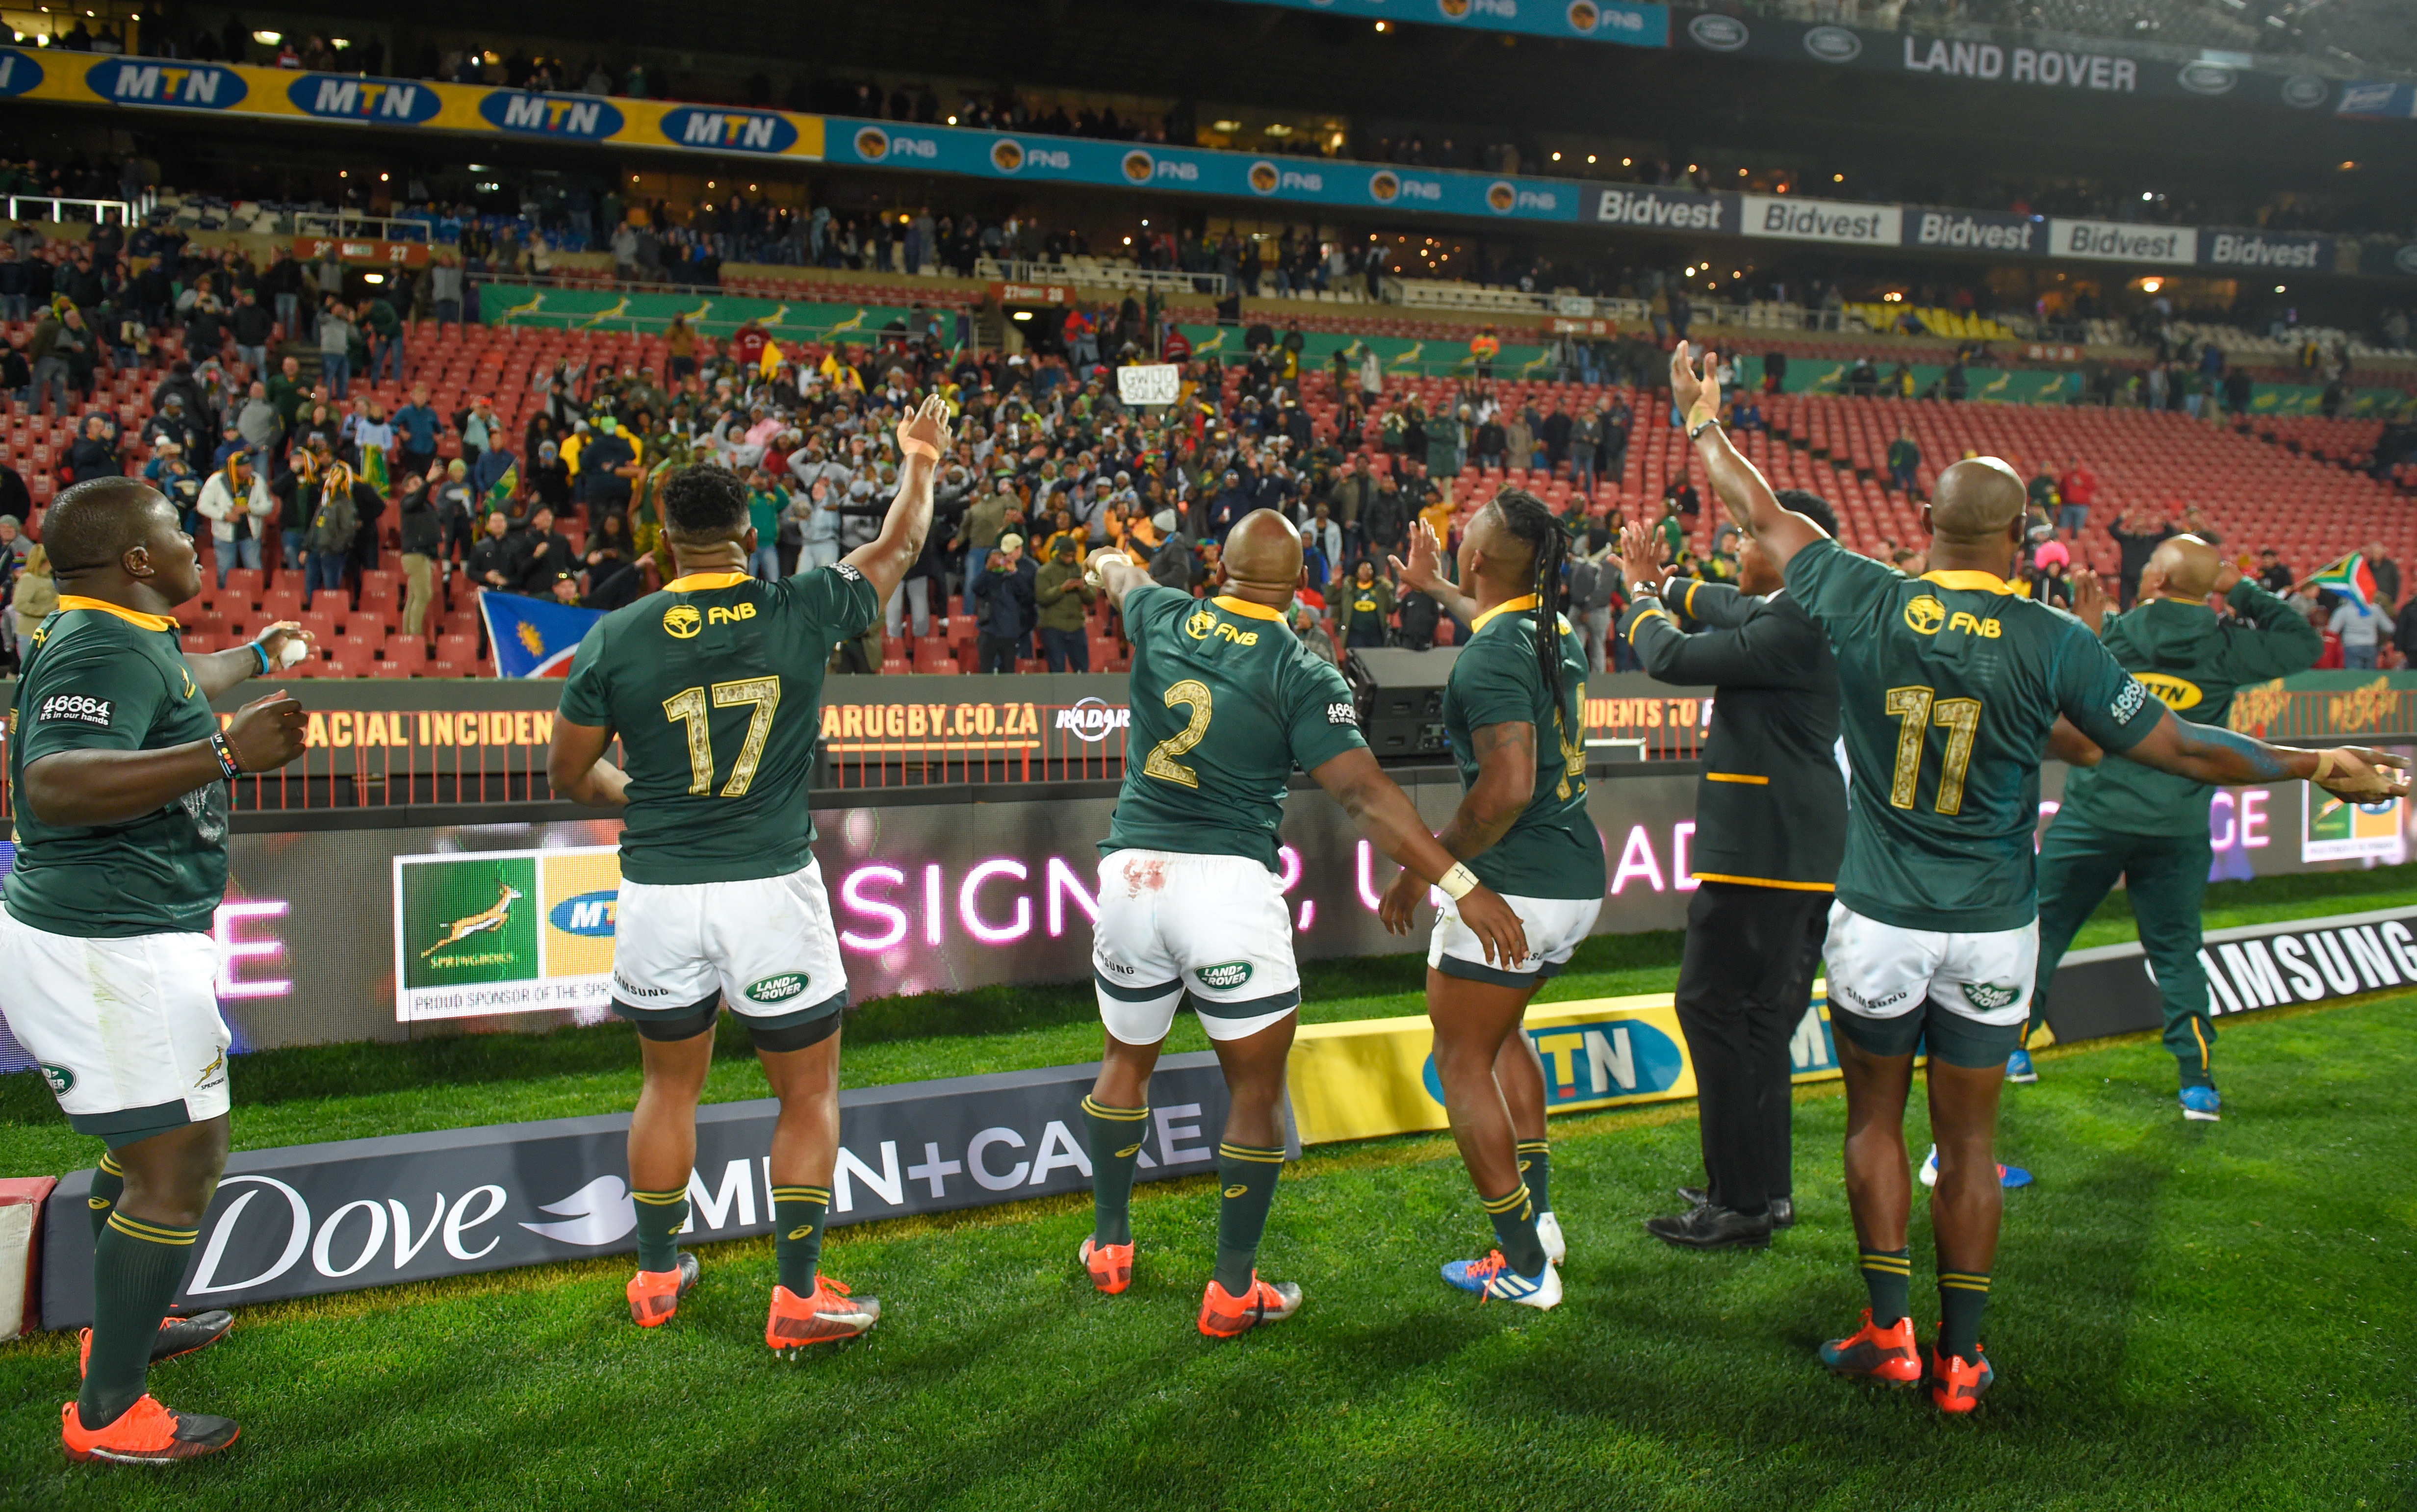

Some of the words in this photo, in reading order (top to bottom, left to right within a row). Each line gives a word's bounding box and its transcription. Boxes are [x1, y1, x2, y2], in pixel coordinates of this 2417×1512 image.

[1601, 9, 1643, 30] FNB
[1904, 35, 2004, 79] LAND
[2012, 48, 2136, 92] ROVER
[113, 67, 219, 103] MTN
[313, 80, 415, 118] MTN
[504, 95, 600, 133] MTN
[684, 112, 776, 148] MTN
[892, 137, 937, 158] FNB
[1028, 149, 1070, 169] FNB
[1157, 160, 1198, 180] FNB
[1282, 172, 1322, 191] FNB
[1401, 180, 1440, 200] FNB
[1518, 191, 1555, 210] FNB
[1599, 190, 1723, 229] Bidvest
[1764, 203, 1880, 238] Bidvest
[1919, 213, 2033, 250] Bidvest
[2070, 225, 2178, 258] Bidvest
[2212, 234, 2319, 267] Bidvest
[708, 602, 756, 625] FNB
[1949, 612, 2001, 638] FNB
[32, 628, 52, 648] FN
[1214, 623, 1258, 646] FNB
[40, 712, 51, 720] It's
[81, 713, 108, 725] hands
[43, 695, 110, 717] 46664
[822, 702, 1038, 738] ARUGBY.CO.ZA
[1584, 698, 1662, 727] IDENTS
[1668, 699, 1697, 727] TO
[305, 712, 408, 747] ACIAL
[419, 711, 553, 746] INCIDEN
[663, 675, 780, 797] 17
[1143, 679, 1211, 788] 2
[1885, 685, 1981, 816] 11
[2210, 790, 2270, 852] GE
[571, 900, 618, 928] MT
[215, 900, 293, 999] E
[614, 970, 669, 997] SAMSUNG
[1205, 965, 1237, 976] LAND
[1207, 972, 1246, 986] ROVER
[2144, 921, 2417, 1015] AMSUNG
[757, 976, 789, 992] LAND
[761, 982, 801, 1000] ROVER
[1535, 1027, 1635, 1096] TN
[186, 1175, 507, 1295] Dove
[679, 1103, 1211, 1233] MN+CAE
